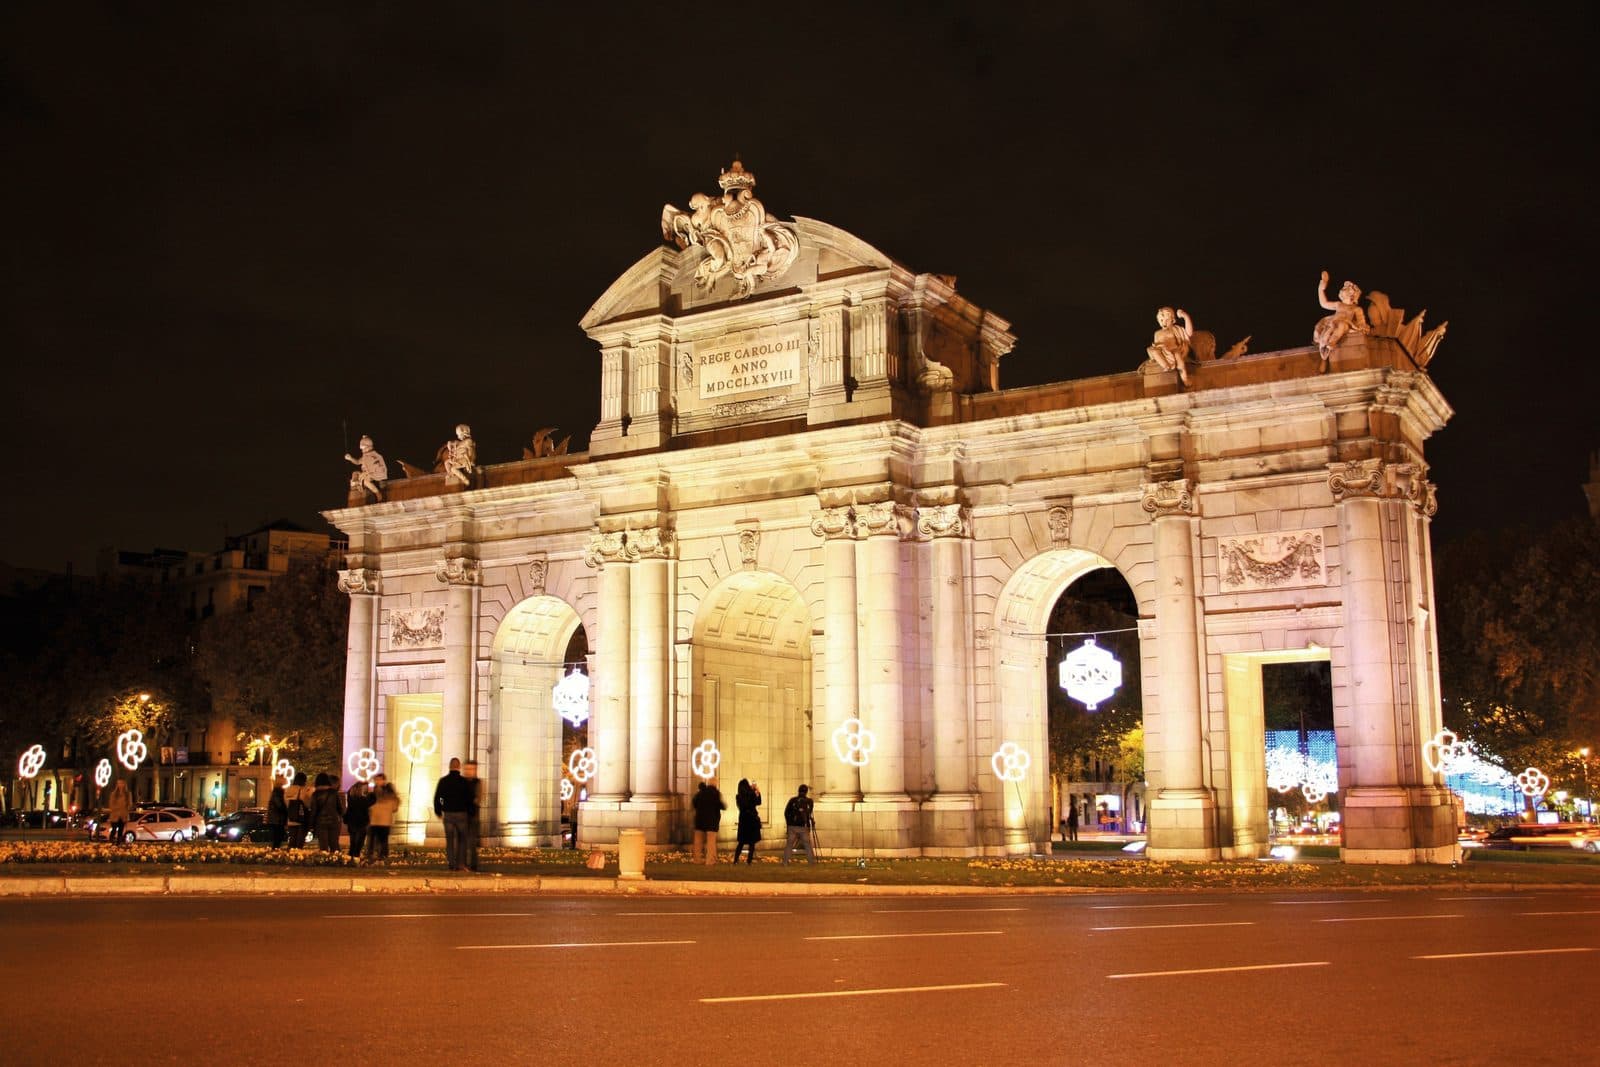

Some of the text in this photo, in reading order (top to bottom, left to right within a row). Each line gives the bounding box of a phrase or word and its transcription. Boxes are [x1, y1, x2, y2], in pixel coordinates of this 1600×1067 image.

[700, 339, 800, 365] REGE CAROLO III
[731, 360, 768, 375] ANNO
[706, 369, 793, 392] MDCCLXXVIII
